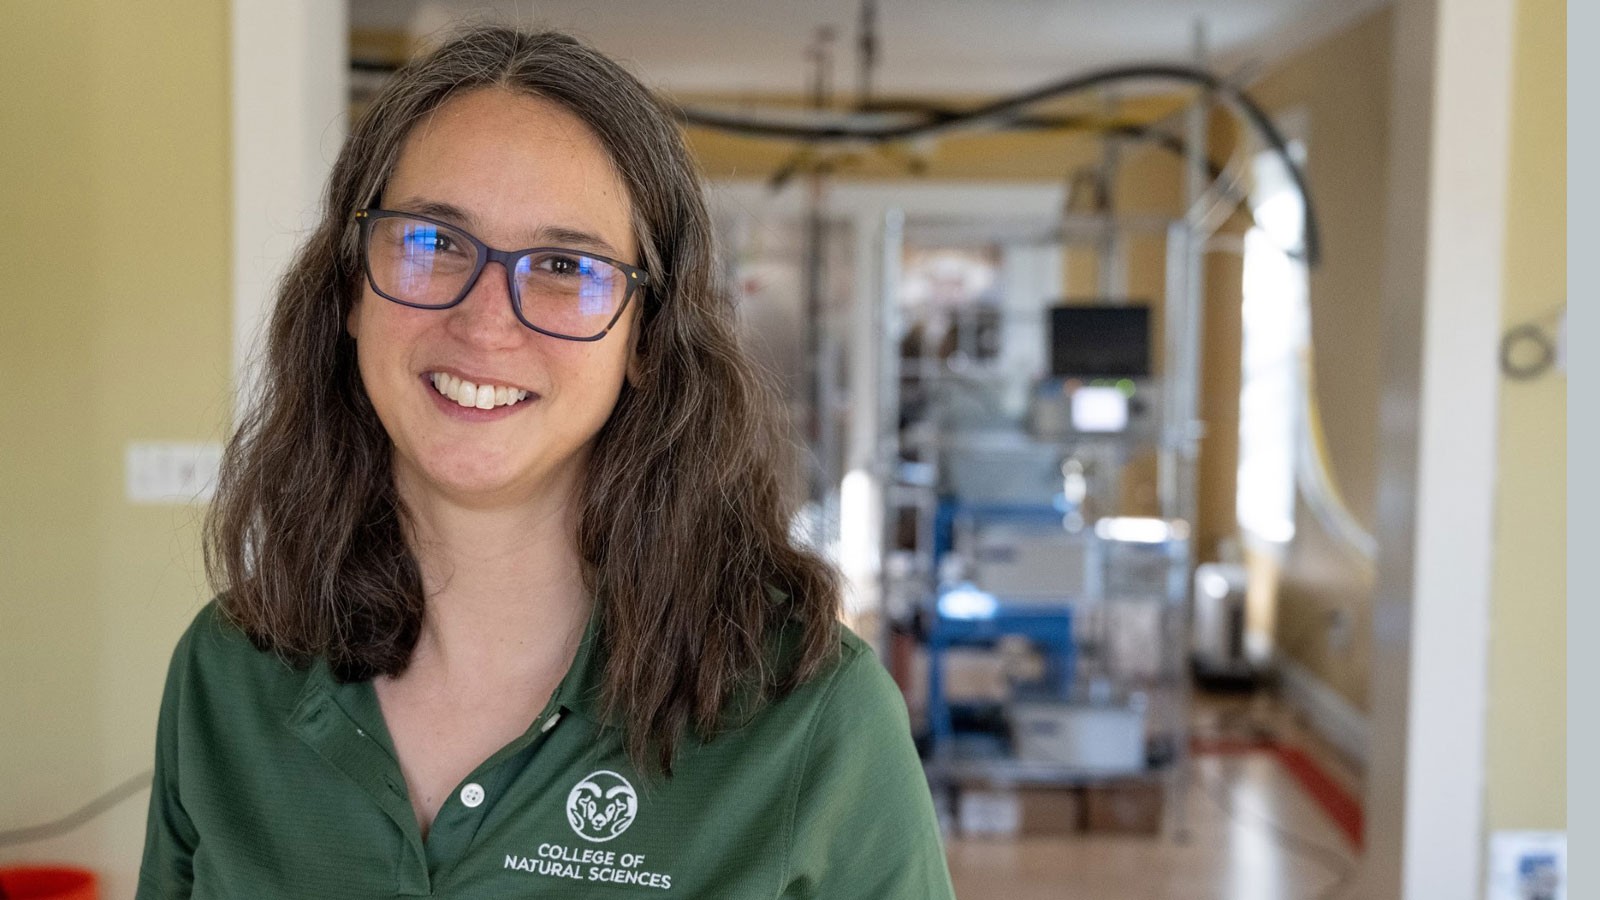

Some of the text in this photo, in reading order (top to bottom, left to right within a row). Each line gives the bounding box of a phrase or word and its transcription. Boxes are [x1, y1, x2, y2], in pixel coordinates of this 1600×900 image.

[538, 843, 645, 868] COLLEGE OF
[504, 854, 672, 889] NATURAL SCIENCES
